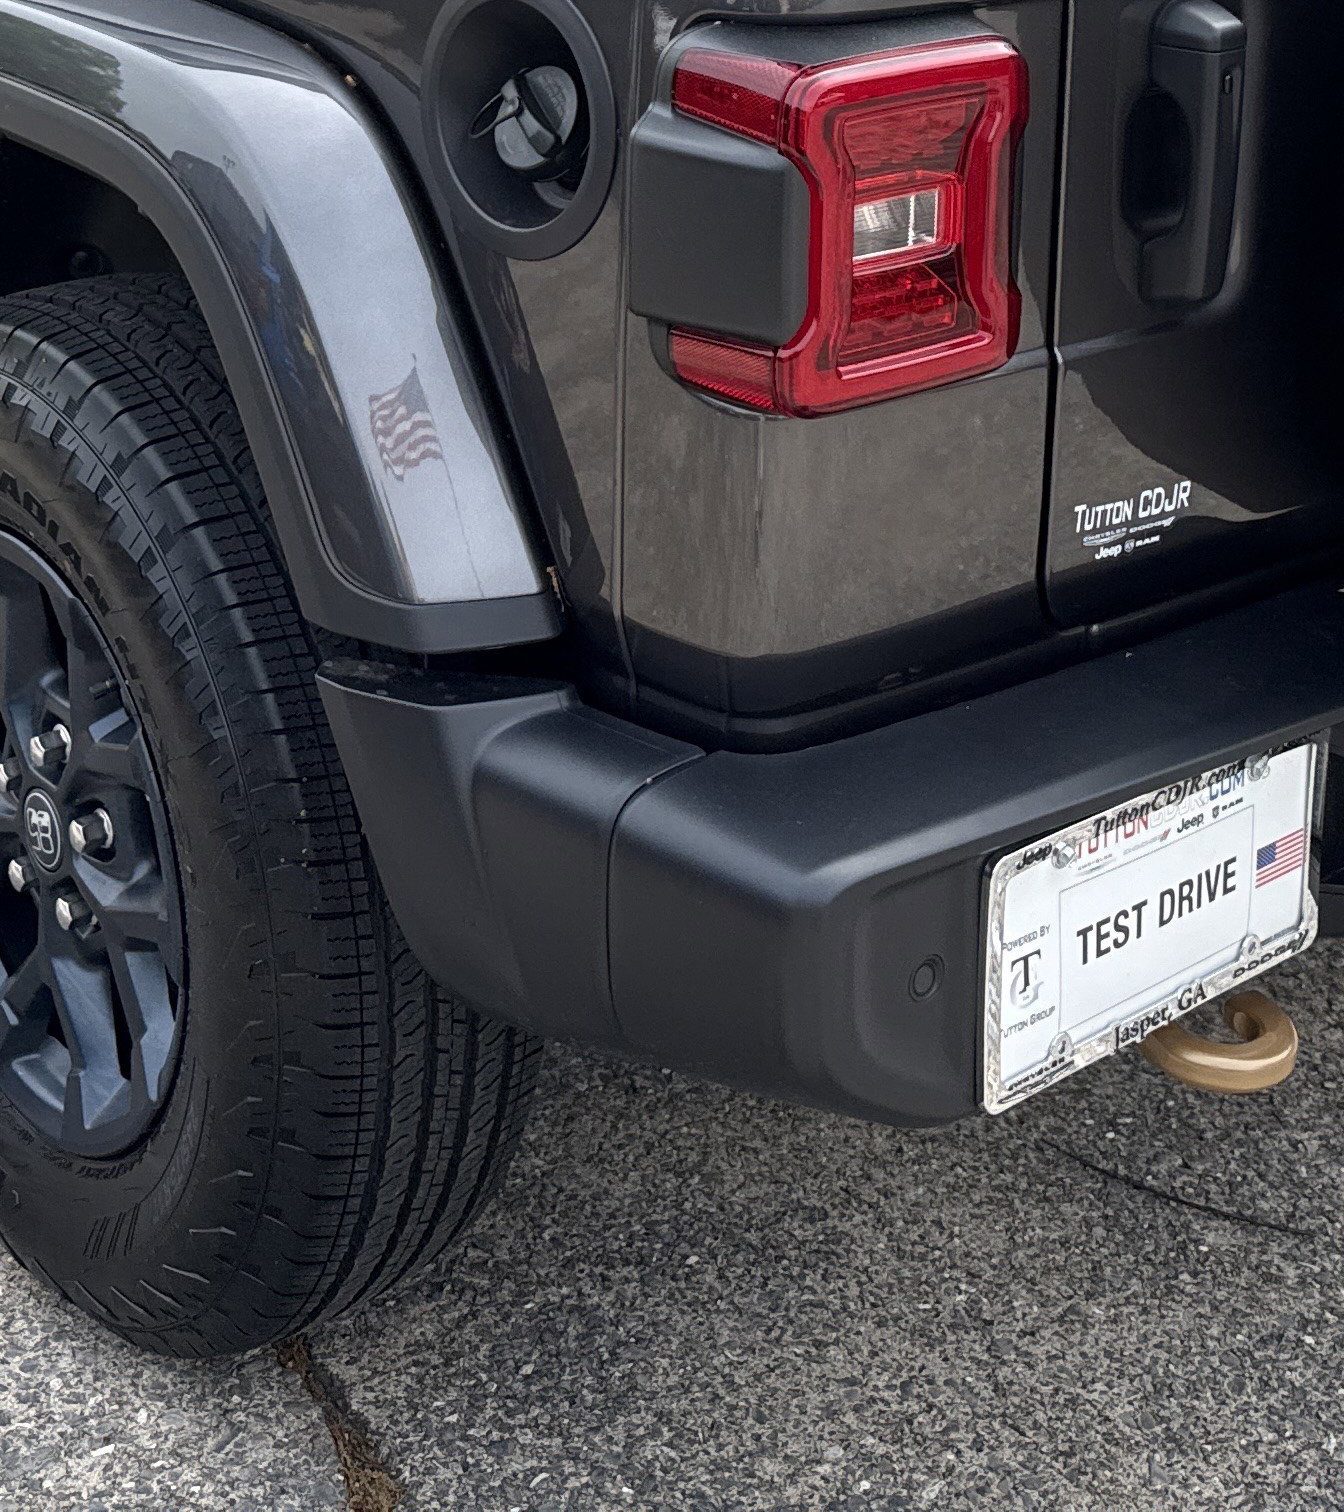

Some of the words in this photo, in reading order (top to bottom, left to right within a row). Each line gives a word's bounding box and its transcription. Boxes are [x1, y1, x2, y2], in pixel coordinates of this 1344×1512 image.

[1074, 497, 1134, 534] TUTTON
[1138, 479, 1192, 519] CDJR
[1094, 543, 1123, 560] Jeep
[1135, 534, 1161, 548] RAM
[1016, 842, 1053, 871] Jeep
[1092, 758, 1247, 839] TuttonCDJR.com
[1176, 812, 1205, 833] Jeep
[1076, 898, 1148, 965] TEST
[1158, 855, 1238, 928] DRIVE
[1113, 1002, 1174, 1051] Jasper,
[1177, 981, 1208, 1012] GA
